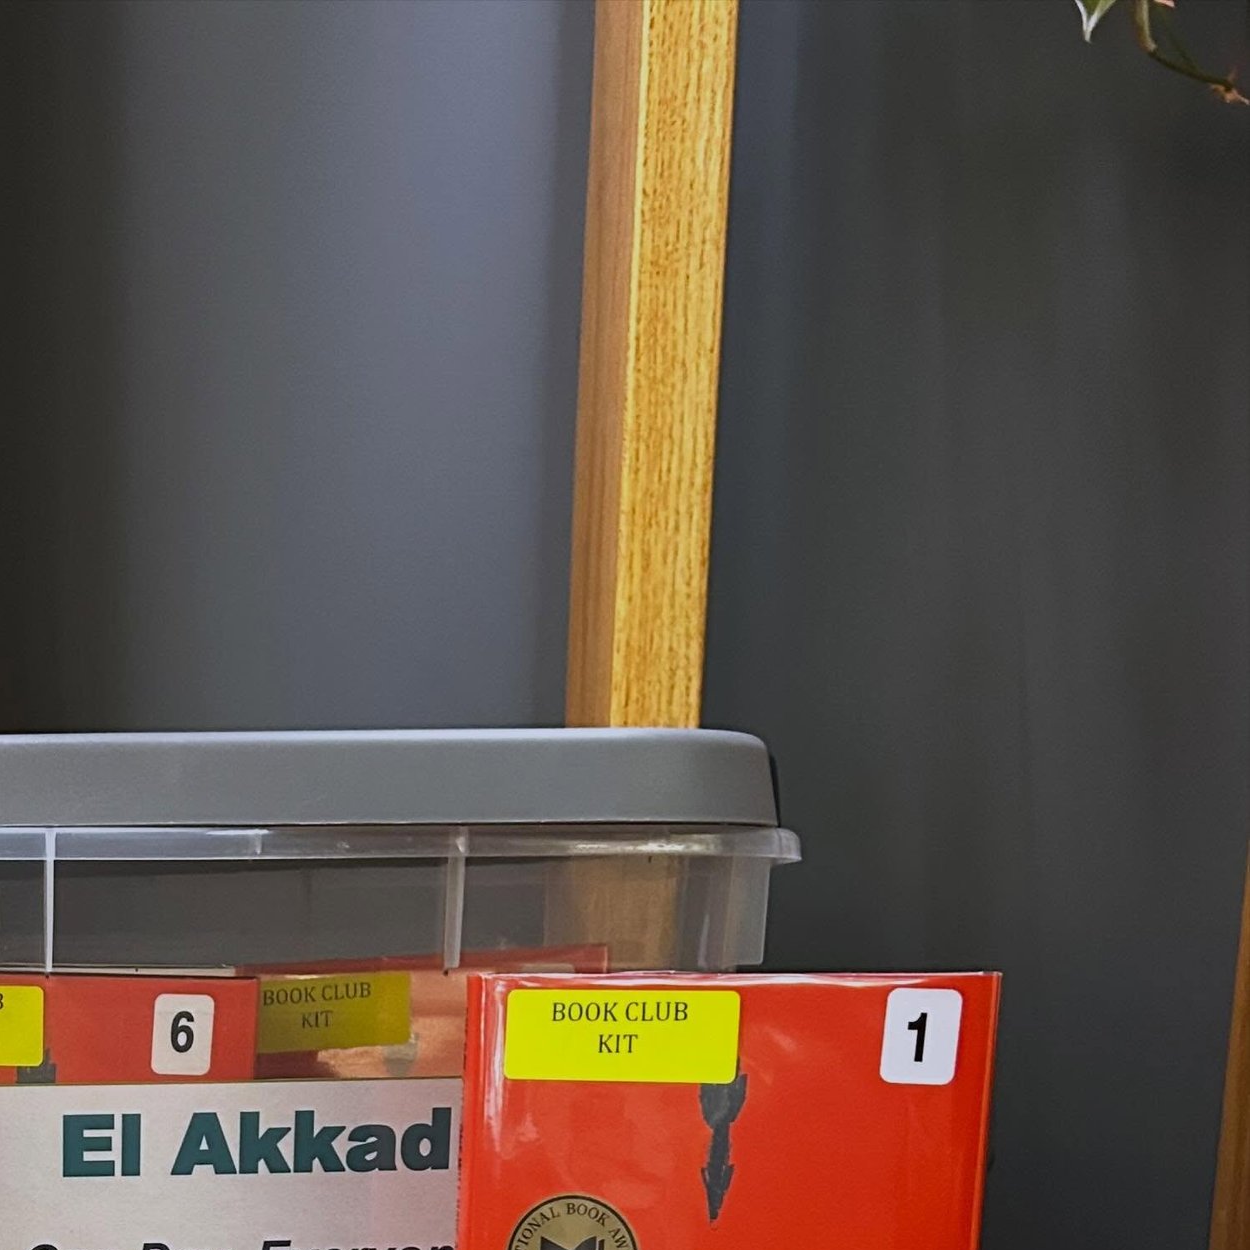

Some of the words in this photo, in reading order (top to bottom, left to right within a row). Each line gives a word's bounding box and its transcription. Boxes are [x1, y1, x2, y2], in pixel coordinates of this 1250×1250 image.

[263, 986, 316, 1006] BOOK
[322, 981, 371, 1000] CLUB
[302, 1011, 333, 1028] KIT
[551, 1001, 617, 1022] BOOK
[625, 1001, 688, 1022] CLUB
[170, 1011, 195, 1053] 6
[598, 1034, 638, 1054] KIT
[907, 1012, 928, 1062] 1
[62, 1113, 141, 1177] El
[171, 1107, 450, 1175] Akkad
[565, 1202, 611, 1227] BOOK
